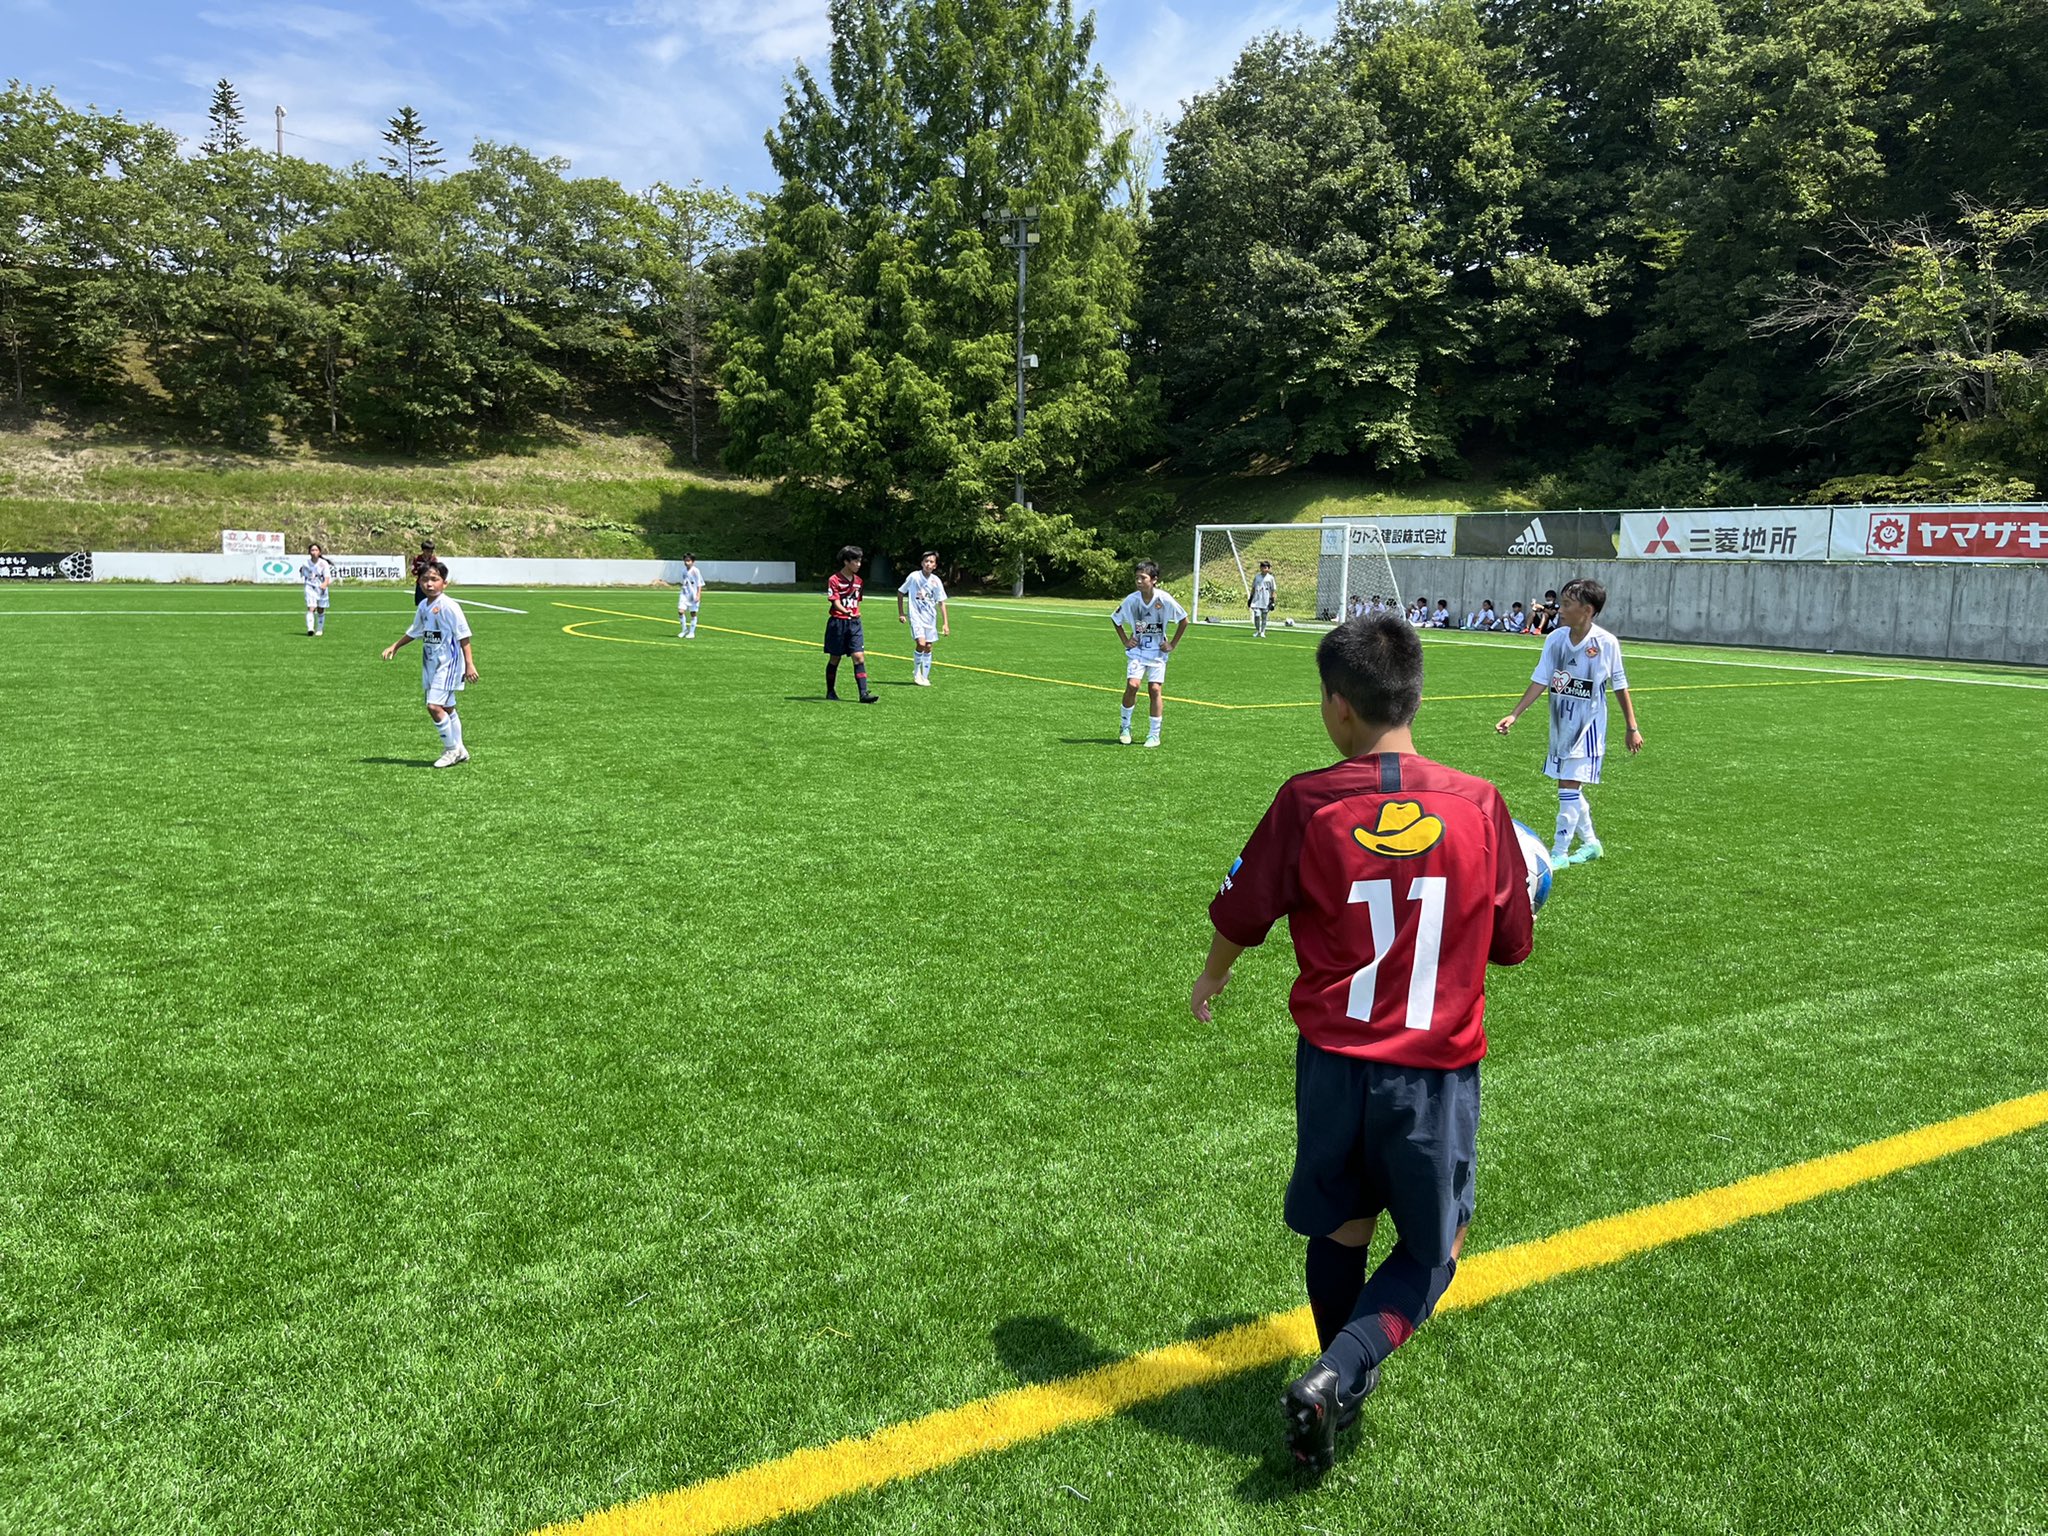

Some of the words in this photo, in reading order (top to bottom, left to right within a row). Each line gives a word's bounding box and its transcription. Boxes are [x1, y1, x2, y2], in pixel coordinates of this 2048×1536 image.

[1507, 542, 1554, 556] adidas
[1689, 526, 1797, 554] 三菱地所
[1918, 521, 2048, 549] ヤマザキ
[1560, 699, 1575, 720] 14
[1346, 877, 1447, 1031] 11
